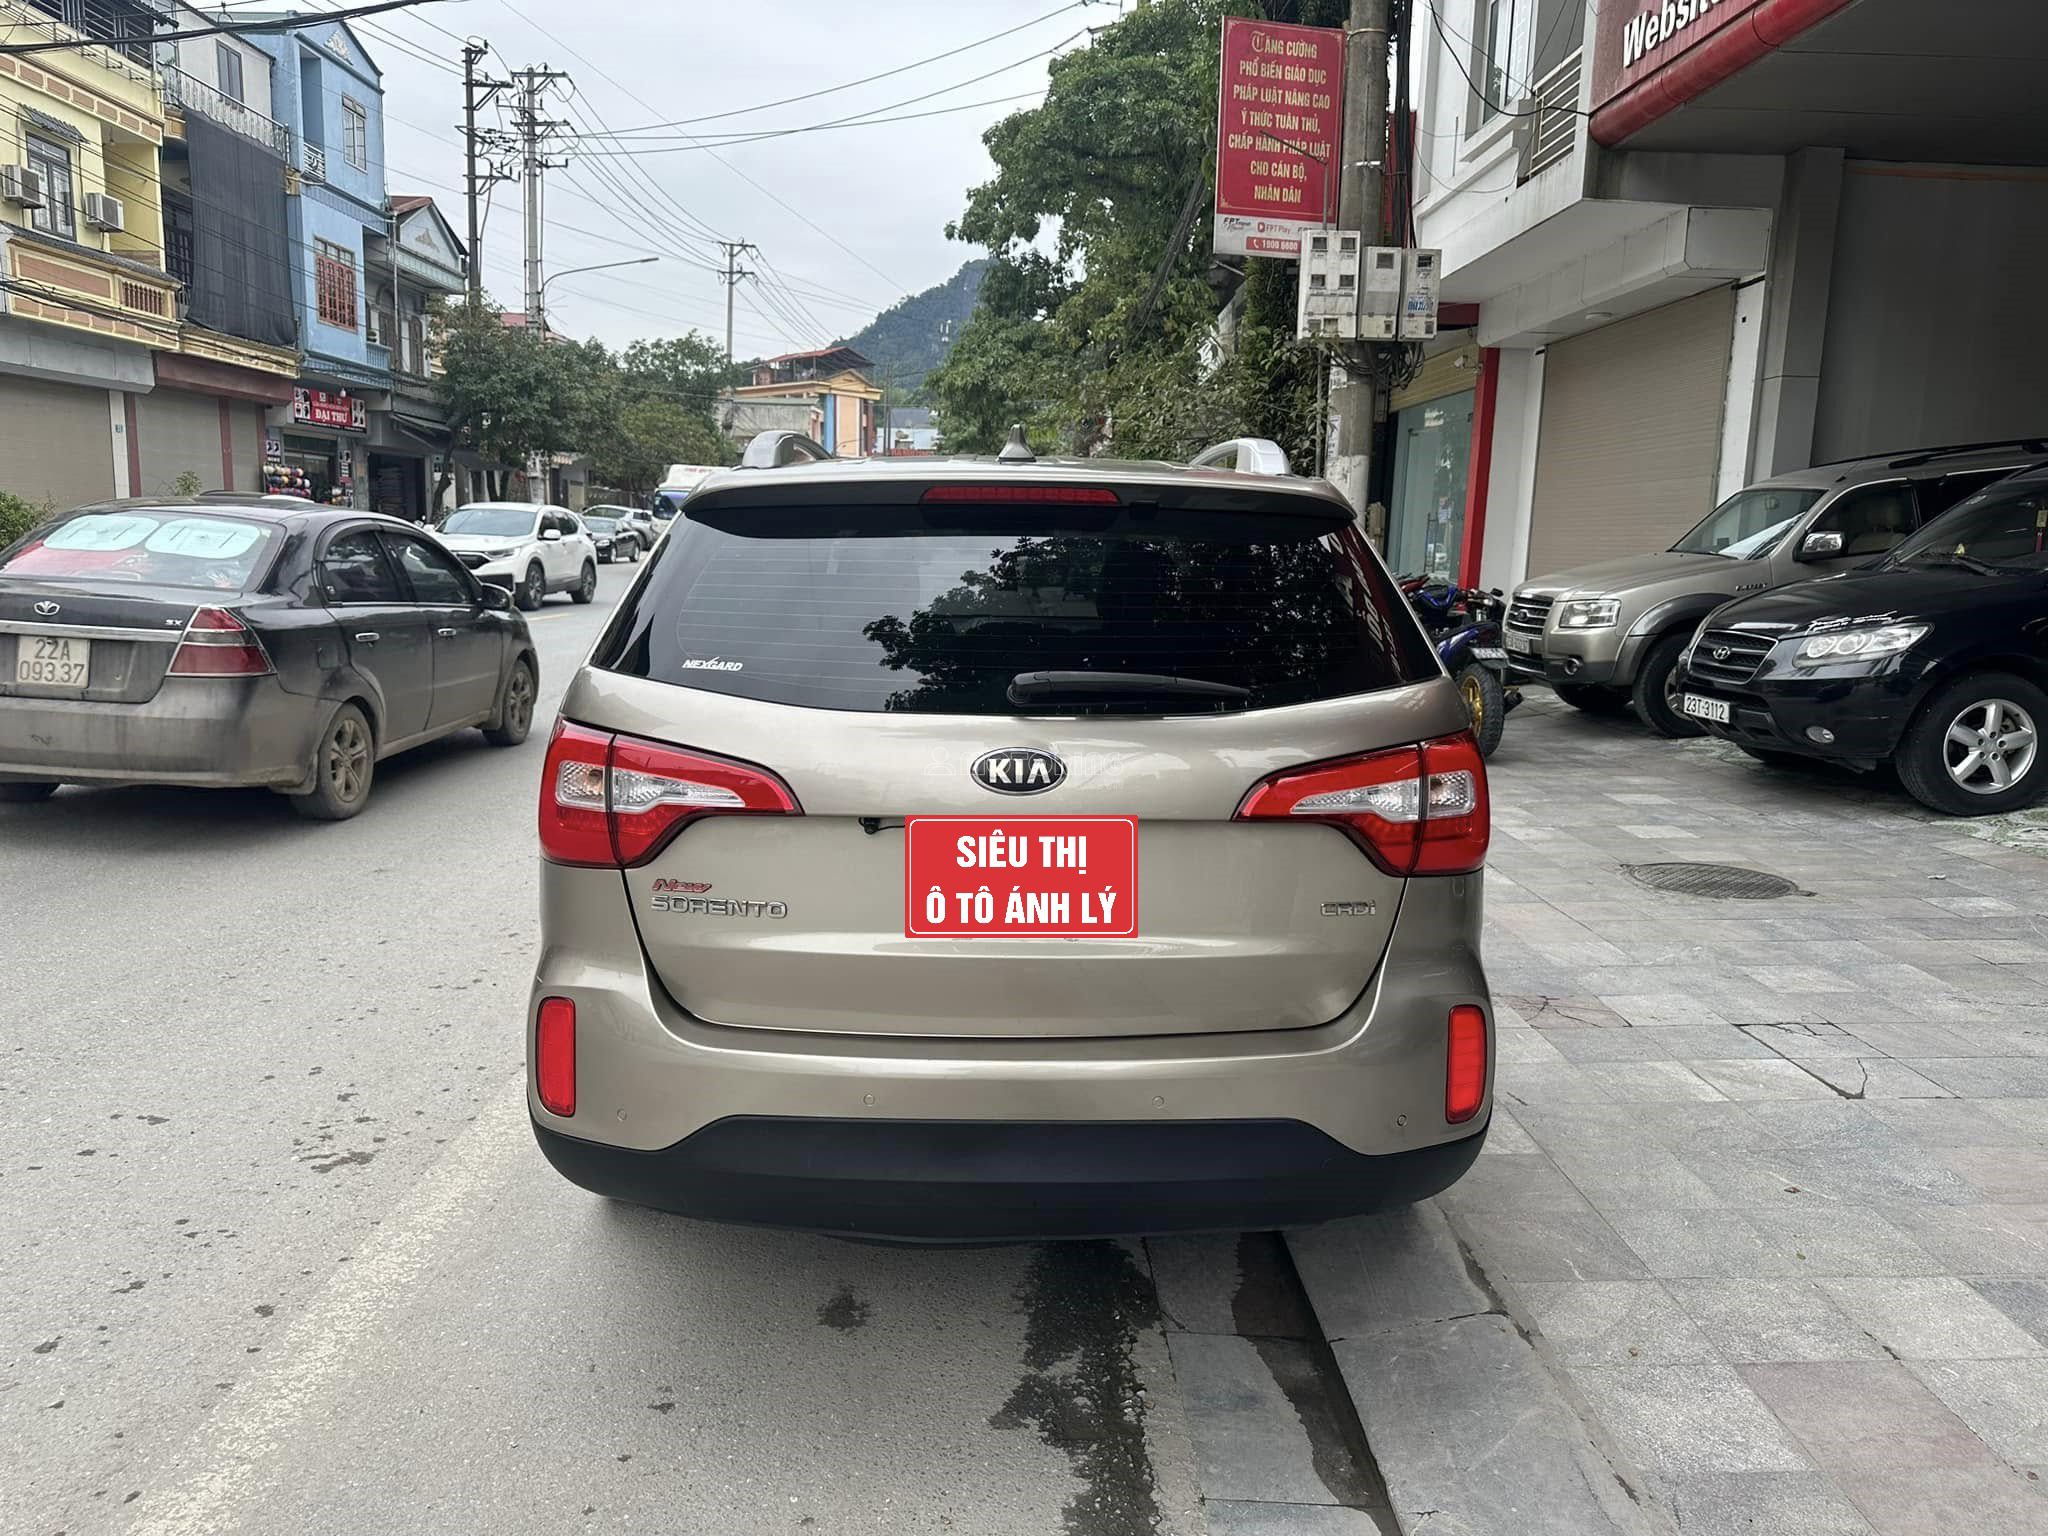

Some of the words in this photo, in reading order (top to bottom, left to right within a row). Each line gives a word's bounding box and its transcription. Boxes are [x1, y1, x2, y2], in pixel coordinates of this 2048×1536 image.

[1286, 39, 1318, 59] CƯỜNG
[1239, 56, 1259, 77] PHỔ
[1260, 60, 1283, 80] BIẾN
[1284, 64, 1306, 82] GIÁO
[1308, 69, 1327, 87] DỤC
[1233, 83, 1258, 101] PHÁP
[1260, 86, 1283, 107] LUẬT
[1284, 88, 1310, 107] NÂNG
[1312, 93, 1330, 109] CAO
[1249, 109, 1273, 127] THỨC
[1274, 112, 1299, 130] TUÂN
[1228, 130, 1253, 150] CHẤP
[1255, 135, 1280, 153] HÀNH
[1309, 140, 1331, 161] LUẬT
[1250, 160, 1269, 176] CHO
[1271, 160, 1290, 178] CÁN
[1254, 184, 1280, 202] NHÂN
[1282, 185, 1301, 204] DÂN
[35, 639, 70, 660] 22A
[19, 661, 85, 683] 093.37
[682, 657, 743, 671] NEXGARD
[988, 758, 1051, 784] KIA
[652, 879, 712, 893] New
[651, 895, 787, 919] SORENTO
